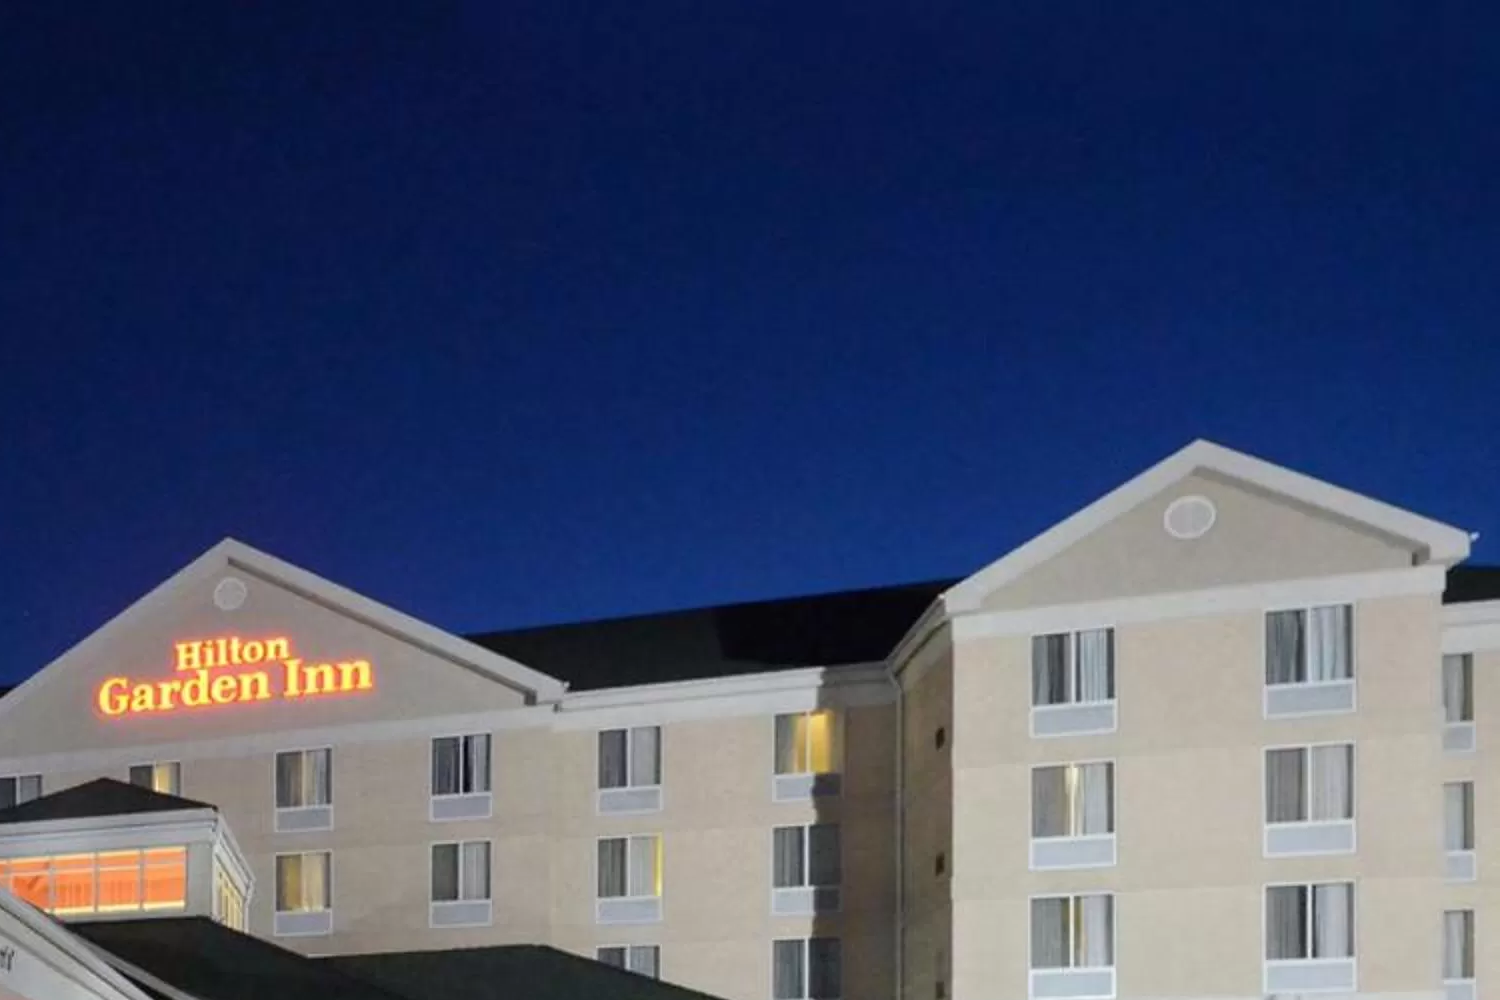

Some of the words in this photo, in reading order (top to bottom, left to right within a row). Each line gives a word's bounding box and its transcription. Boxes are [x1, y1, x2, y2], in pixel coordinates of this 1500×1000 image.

[175, 637, 288, 671] Hilton
[98, 670, 271, 716] Garden
[283, 659, 373, 698] Inn
